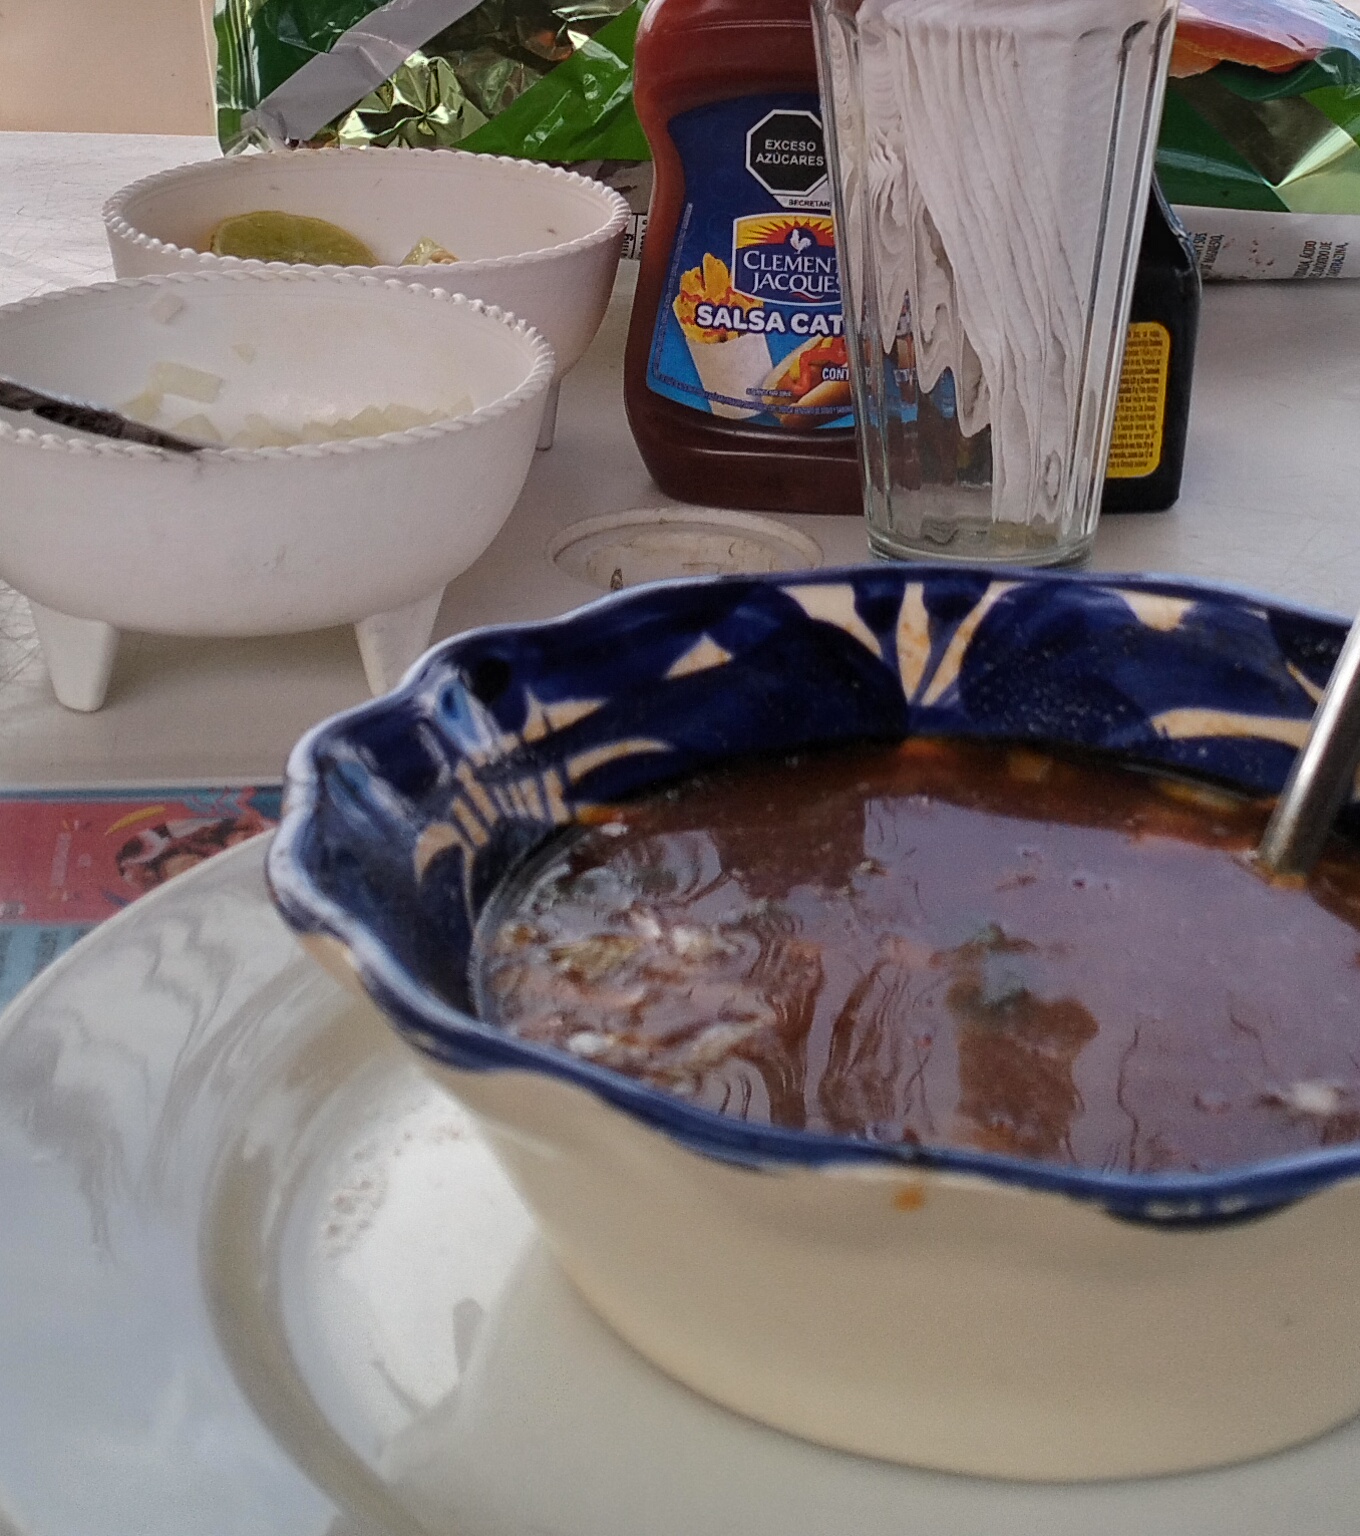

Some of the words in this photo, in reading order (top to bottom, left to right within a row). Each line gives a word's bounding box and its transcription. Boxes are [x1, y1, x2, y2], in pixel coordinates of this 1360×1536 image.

[764, 139, 817, 152] EXCESO
[755, 152, 825, 166] AZÚCARES
[696, 305, 786, 332] SALSA
[790, 313, 843, 335] CAT
